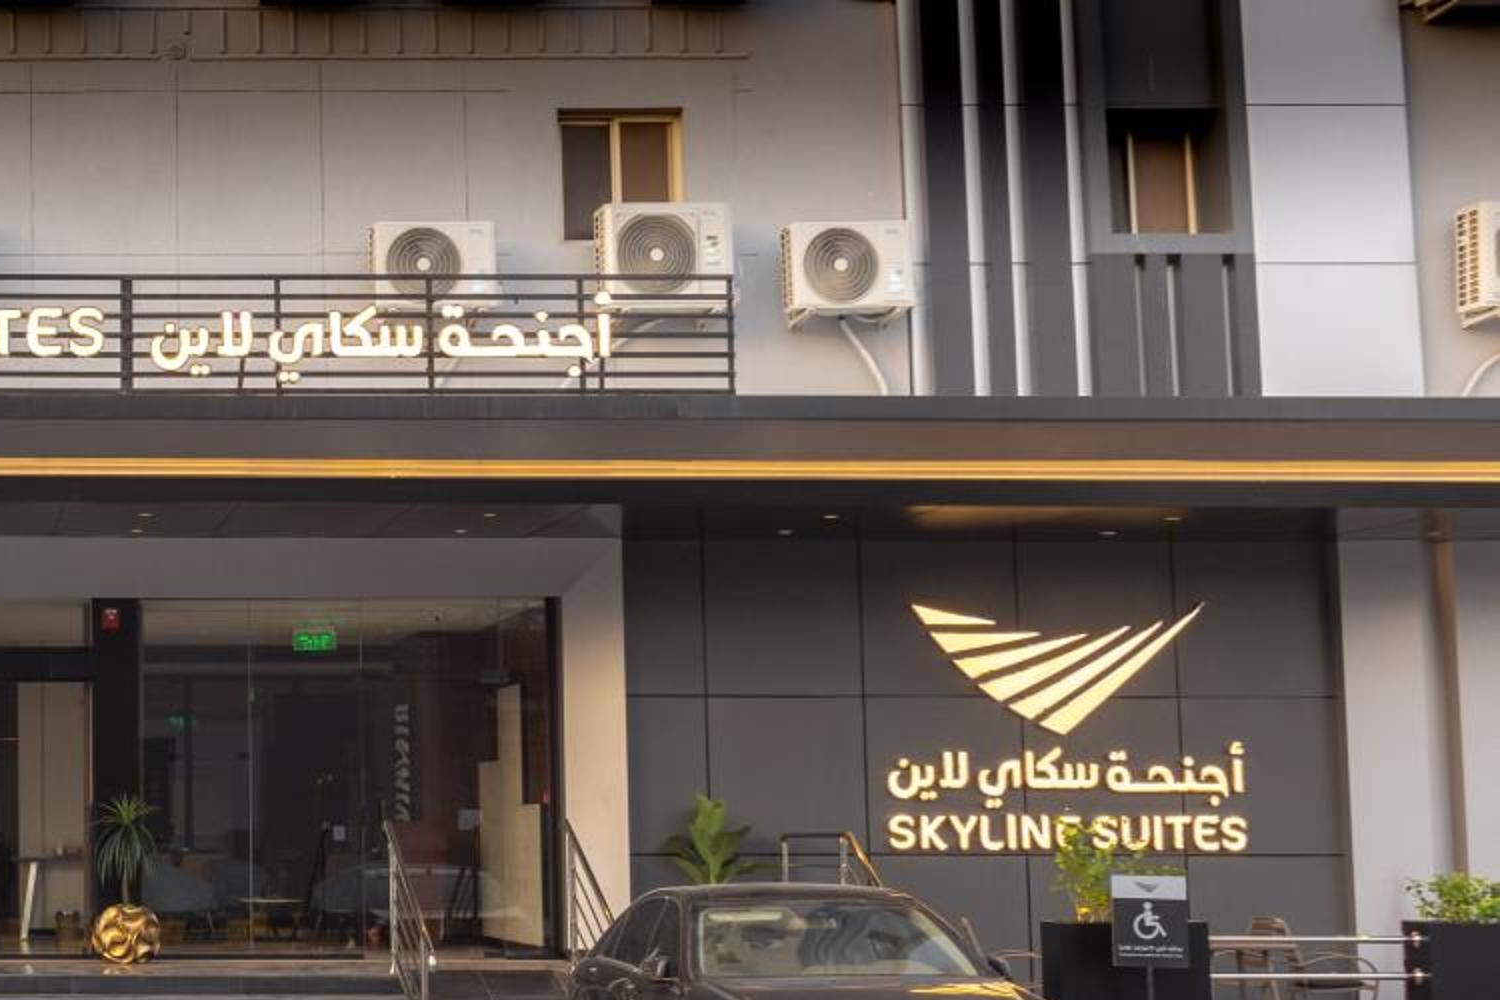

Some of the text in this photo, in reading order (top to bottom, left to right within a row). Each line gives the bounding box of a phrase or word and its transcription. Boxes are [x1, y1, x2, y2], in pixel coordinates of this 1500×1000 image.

[151, 291, 612, 382] أجنحة سكاي لاين
[887, 740, 1246, 809] أجنحة سكاي لاين
[1091, 814, 1248, 852] SUITES
